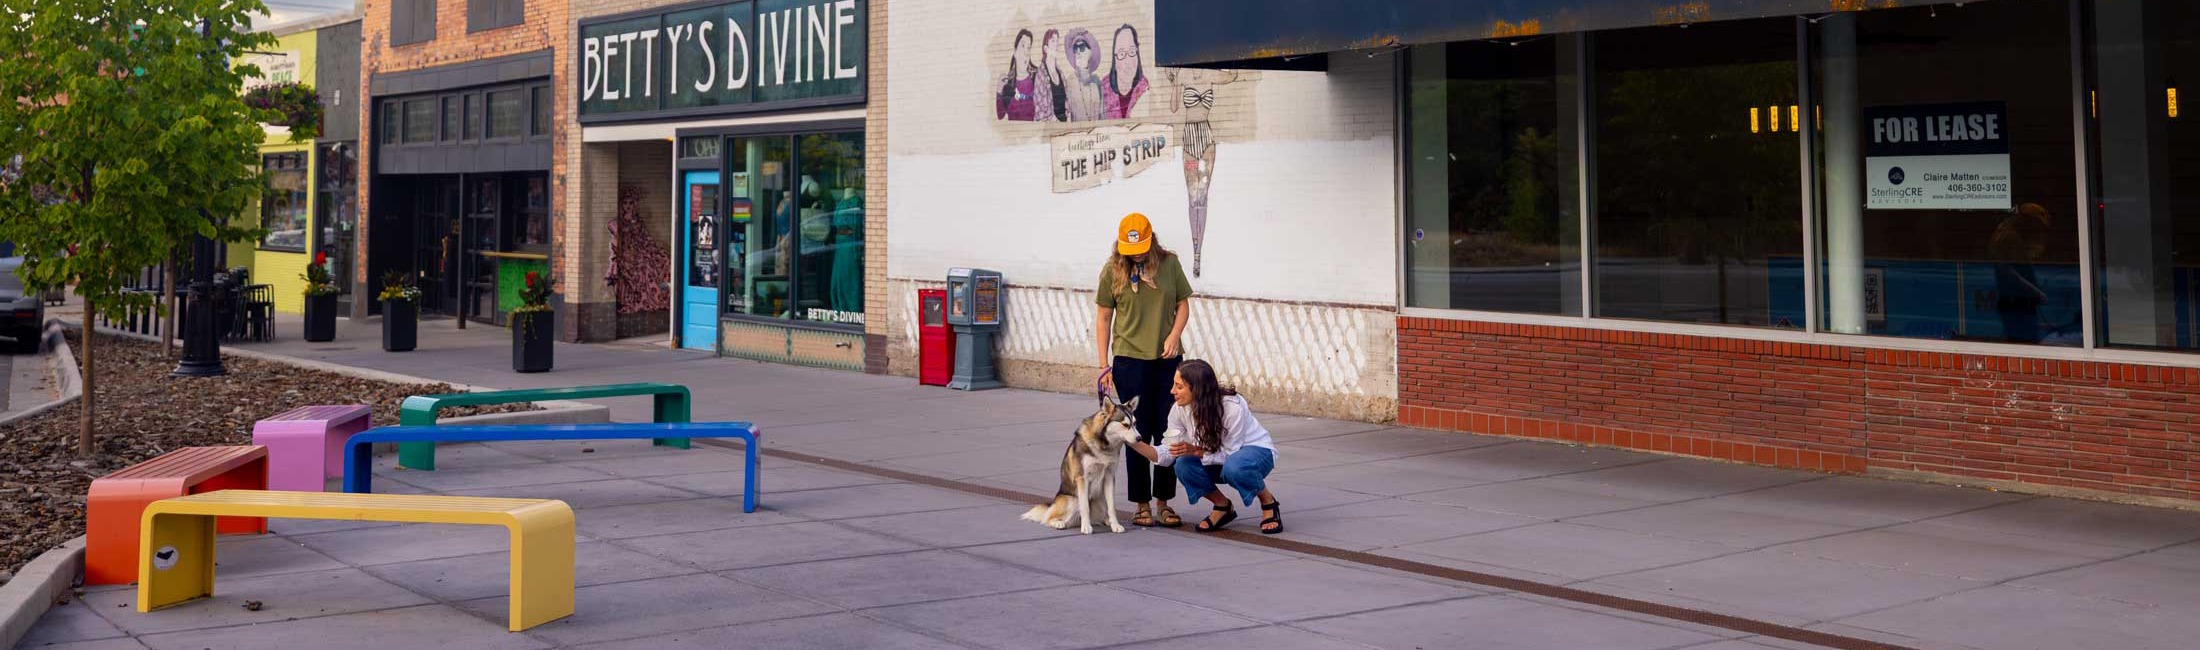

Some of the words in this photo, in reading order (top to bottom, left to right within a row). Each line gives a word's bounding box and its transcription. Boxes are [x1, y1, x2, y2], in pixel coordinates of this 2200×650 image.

[583, 20, 715, 101] BETTY'S
[727, 0, 857, 90] DIVINE
[1873, 117, 1919, 143] FOR
[1925, 114, 2000, 141] LEASE
[1061, 158, 1088, 181] THE
[1093, 149, 1117, 175] HIP
[1122, 136, 1166, 166] STRIP
[1923, 172, 1948, 181] Claire
[1947, 183, 2007, 192] 406-360-3102
[807, 307, 838, 321] BETTY'S
